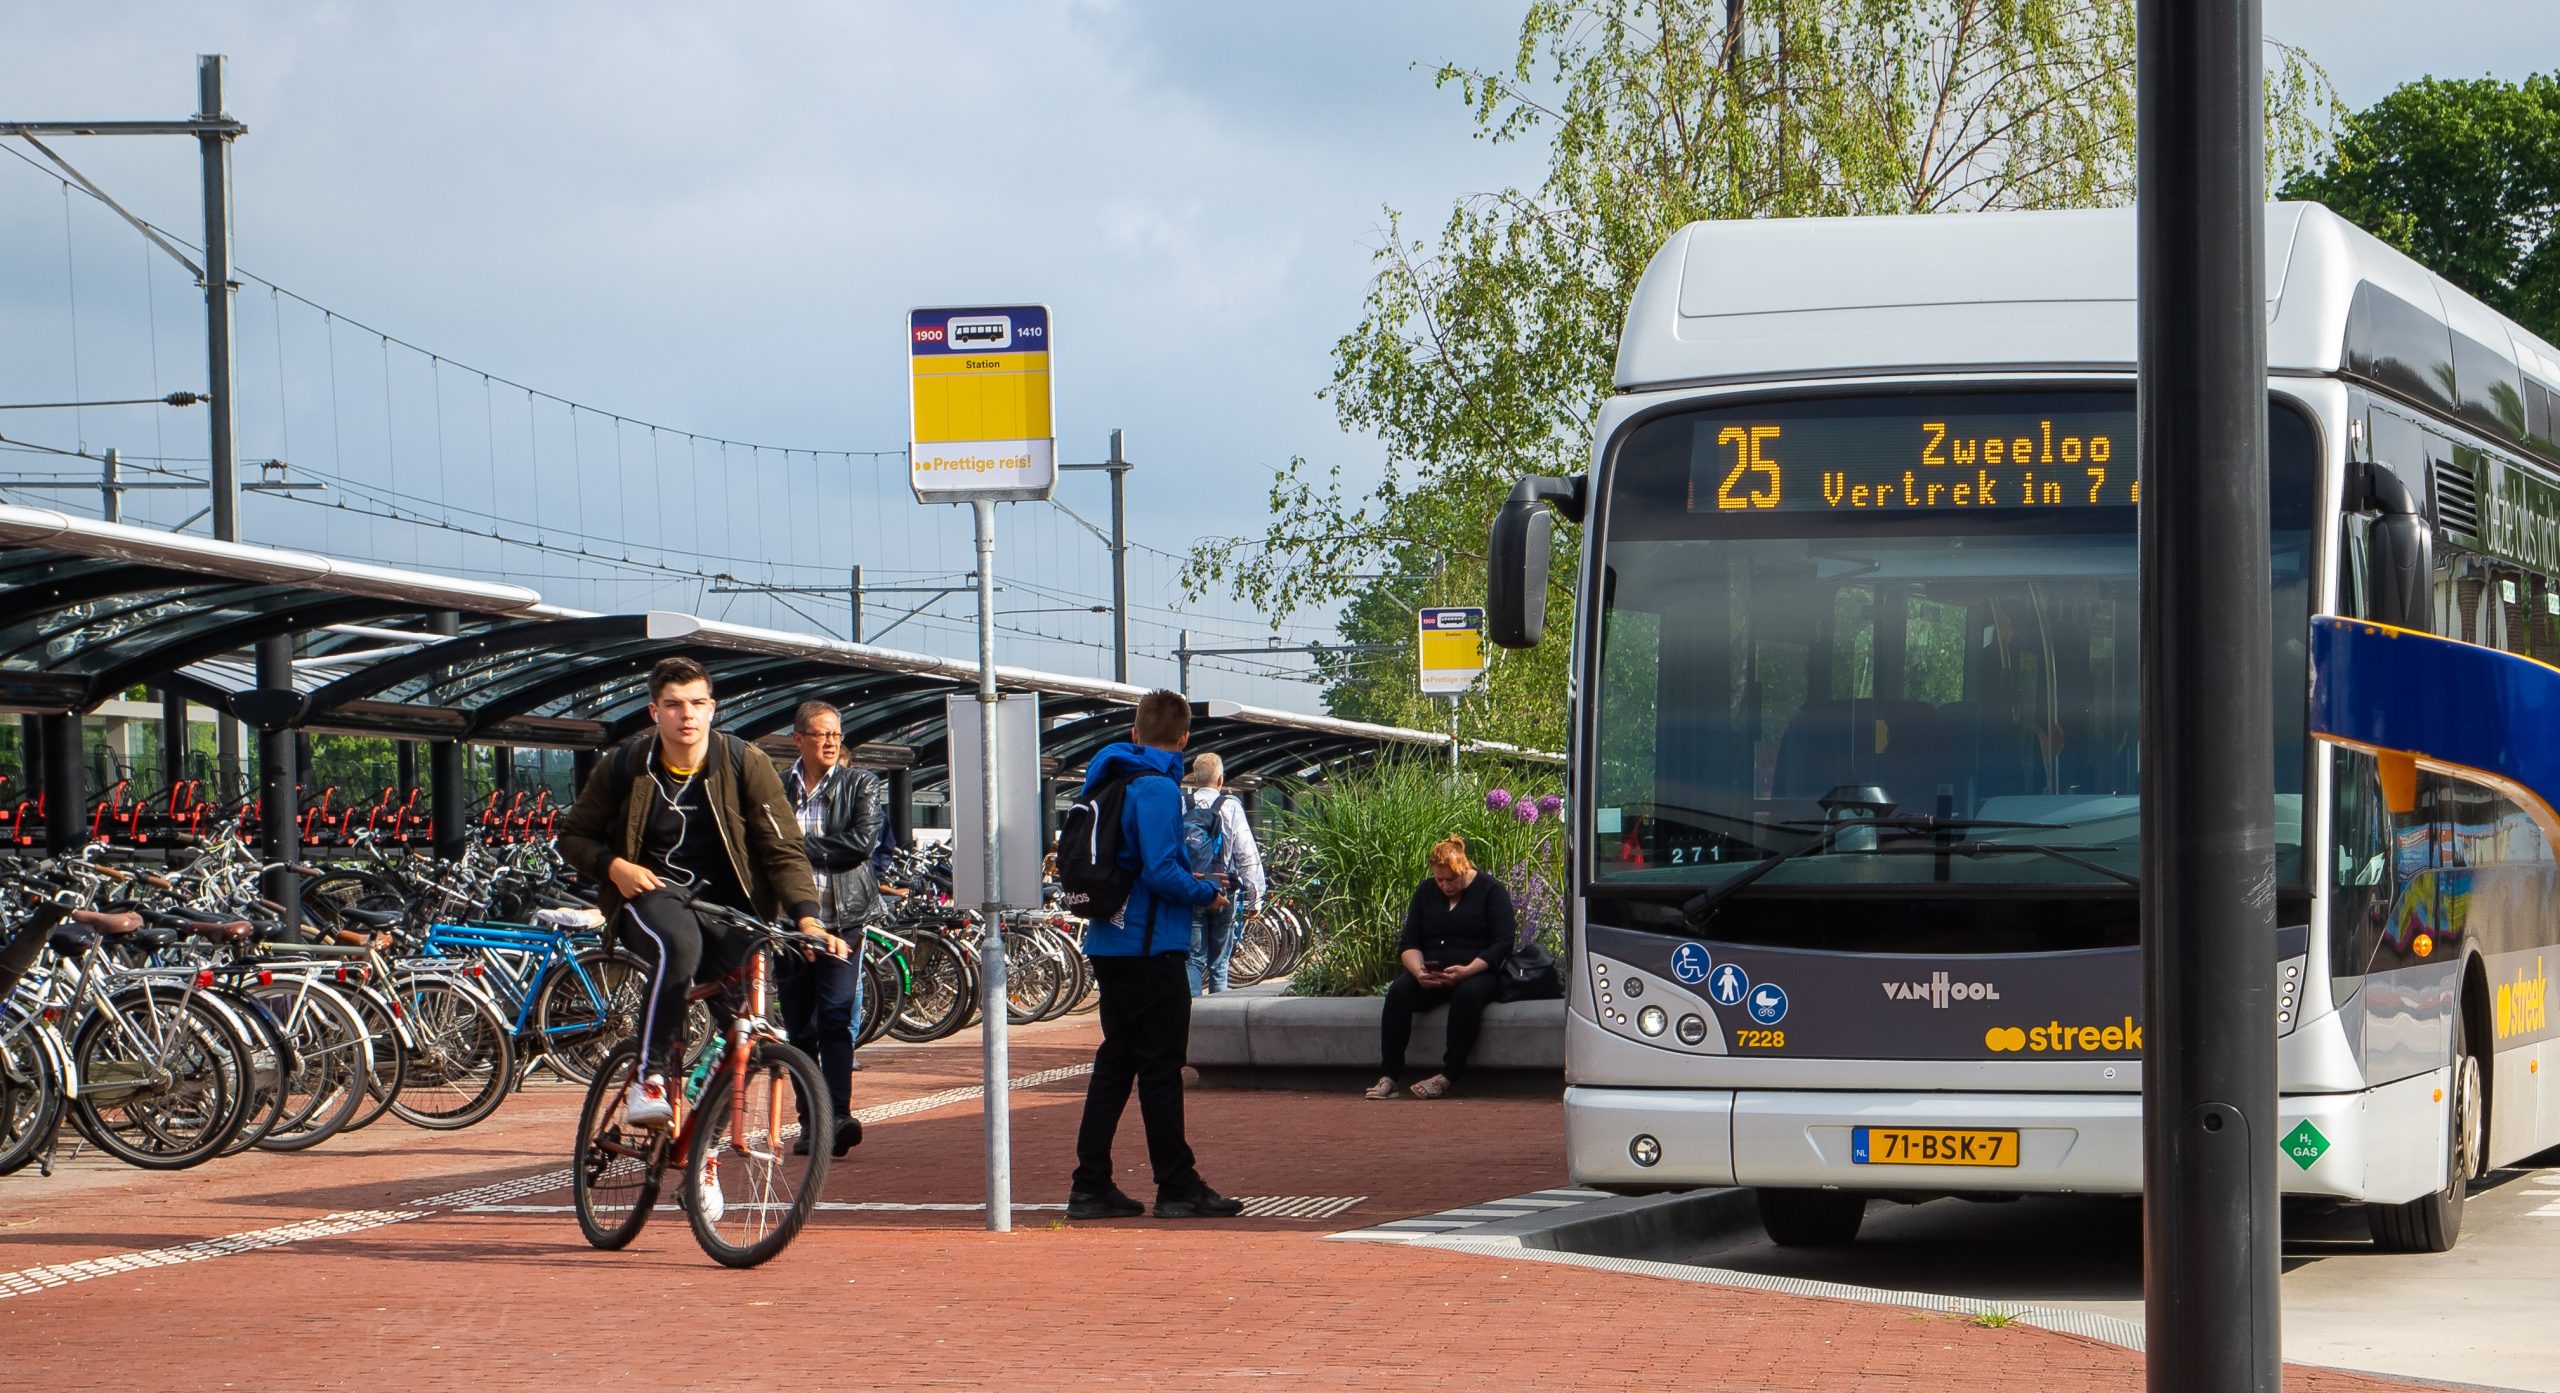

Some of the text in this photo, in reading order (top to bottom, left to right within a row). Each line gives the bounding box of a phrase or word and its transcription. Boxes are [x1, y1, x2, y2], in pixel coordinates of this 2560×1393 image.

[915, 330, 943, 341] 1900
[1017, 326, 1043, 338] 1410
[966, 360, 1001, 370] Station
[1922, 420, 2112, 465] Zweeloo
[934, 454, 1032, 474] Prettige reis!
[1717, 426, 1781, 509] 25
[1822, 470, 1996, 508] Vertrek
[2022, 474, 2061, 505] in
[2087, 467, 2105, 504] 7
[2484, 468, 2514, 558] deze
[2512, 478, 2537, 566] bus
[2511, 955, 2547, 1037] streek
[1736, 1030, 1785, 1048] 7228
[2029, 1016, 2142, 1051] streek
[1856, 1149, 1867, 1157] NL
[1883, 1134, 2004, 1161] 71-BSK-7
[2293, 1147, 2318, 1157] GAS
